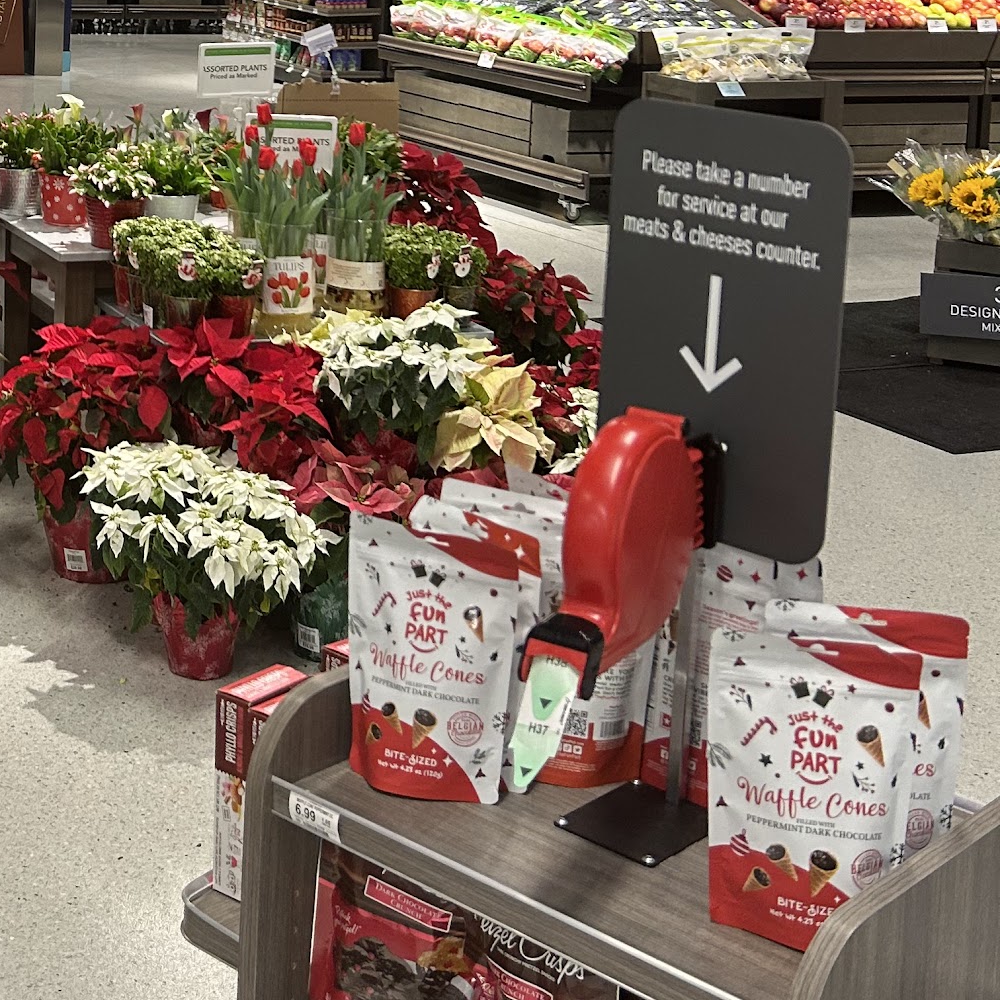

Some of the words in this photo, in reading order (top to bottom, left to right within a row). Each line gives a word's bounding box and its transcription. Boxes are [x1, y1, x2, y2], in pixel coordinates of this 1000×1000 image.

[240, 64, 267, 72] PLANTS
[642, 149, 693, 179] Please
[696, 160, 731, 185] take
[734, 169, 745, 188] a
[748, 172, 811, 200] number
[657, 184, 681, 208] for
[682, 194, 737, 220] service
[740, 203, 758, 225] at
[760, 208, 789, 231] our
[623, 214, 669, 239] meats
[672, 219, 686, 243] &
[689, 225, 752, 256] cheeses
[756, 240, 821, 270] counter.
[273, 262, 305, 271] TULIPS
[405, 621, 448, 645] PART
[370, 642, 426, 681] Waffle
[430, 660, 486, 685] Cones
[372, 675, 410, 695] PEPPERMINT
[412, 688, 433, 698] DARK
[434, 693, 480, 705] CHOCOLATE
[226, 701, 237, 733] CRISPS
[447, 720, 484, 731] BELGIAN
[528, 722, 549, 735] H37
[822, 715, 843, 733] the
[225, 731, 236, 764] PHYLLO
[384, 748, 437, 767] BITE-SIZED
[790, 750, 842, 775] PART
[737, 776, 821, 818] Waffle
[826, 793, 888, 818] Cones
[295, 803, 316, 822] 6.99
[746, 813, 803, 833] PEPPERMINT
[805, 826, 831, 837] DARK
[833, 830, 882, 841] CHOCOLATE
[777, 896, 835, 917] BITE-SIZE
